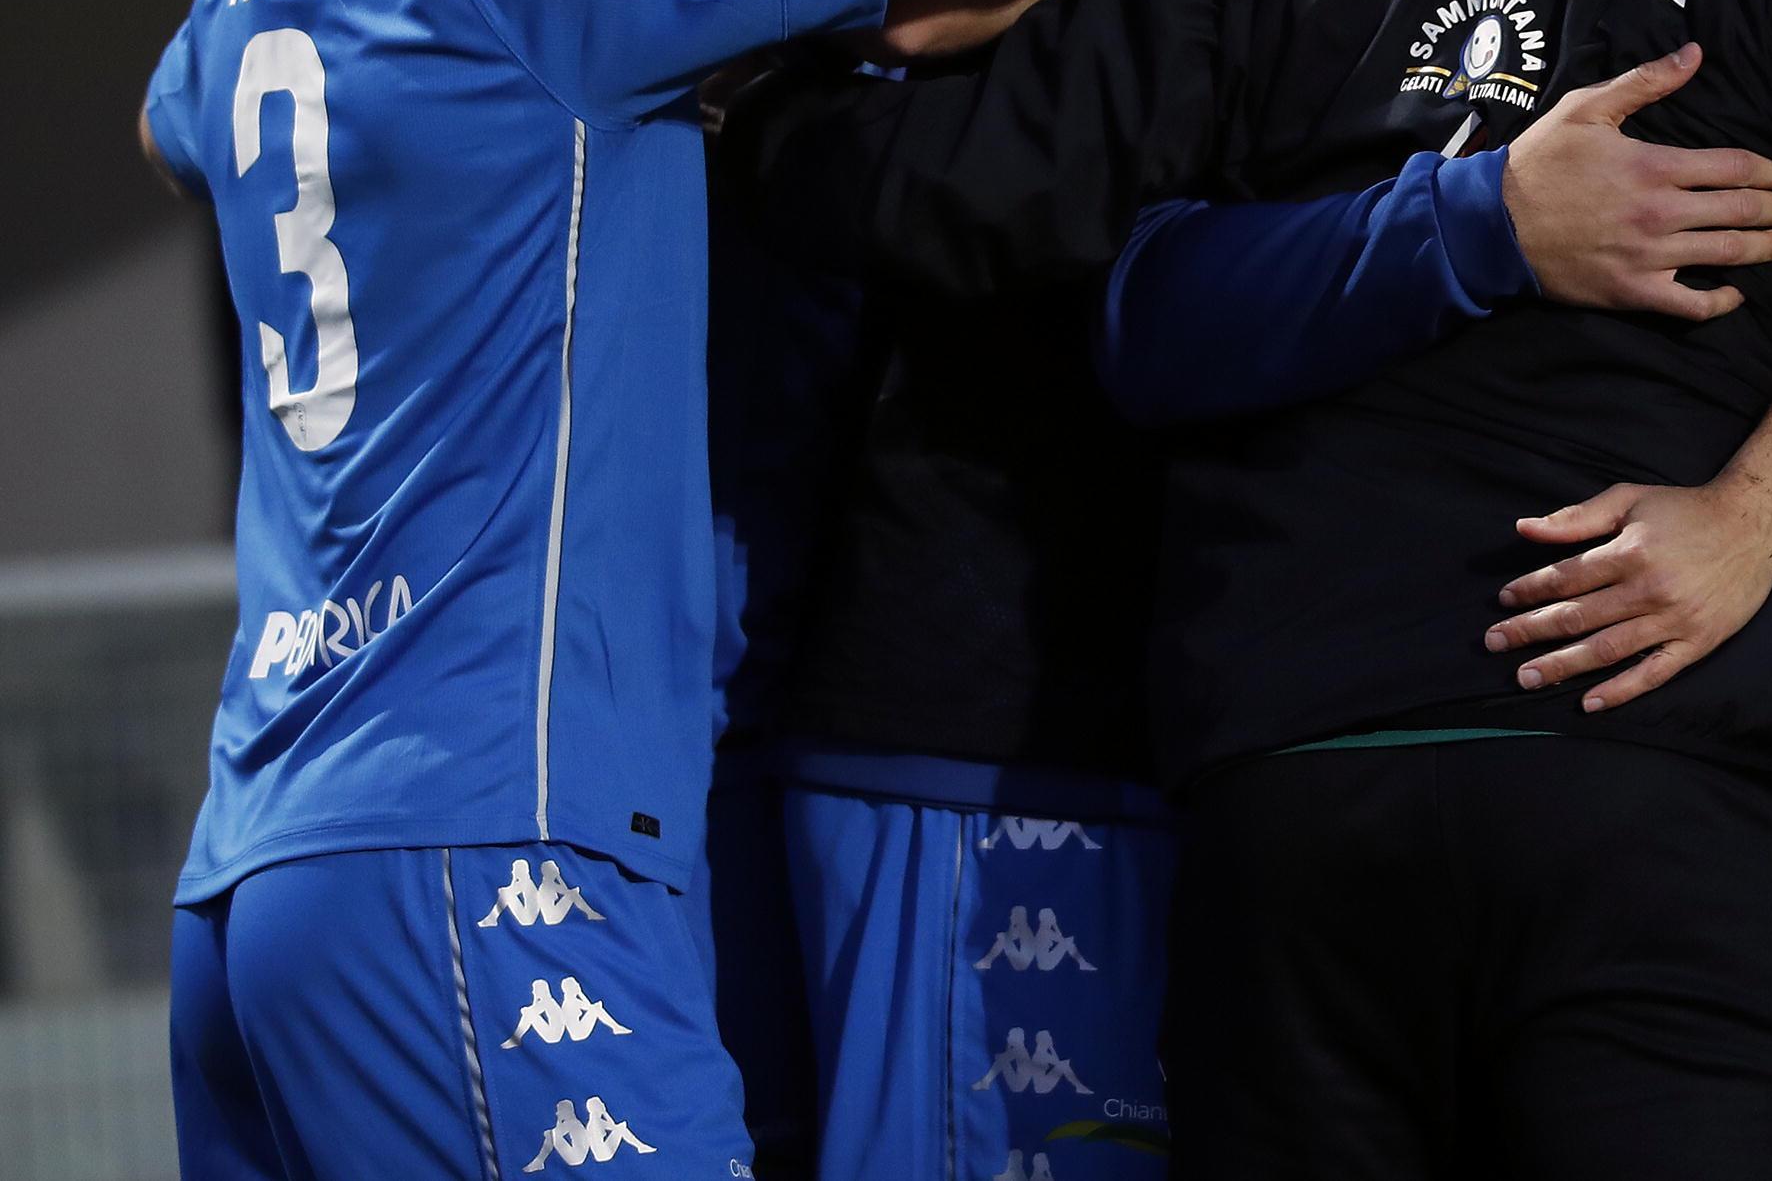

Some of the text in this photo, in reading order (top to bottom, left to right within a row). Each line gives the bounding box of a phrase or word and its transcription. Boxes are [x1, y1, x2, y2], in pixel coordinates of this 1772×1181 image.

[1400, 75, 1444, 94] GELATI
[232, 27, 359, 452] 3
[1103, 1098, 1168, 1122] Chian
